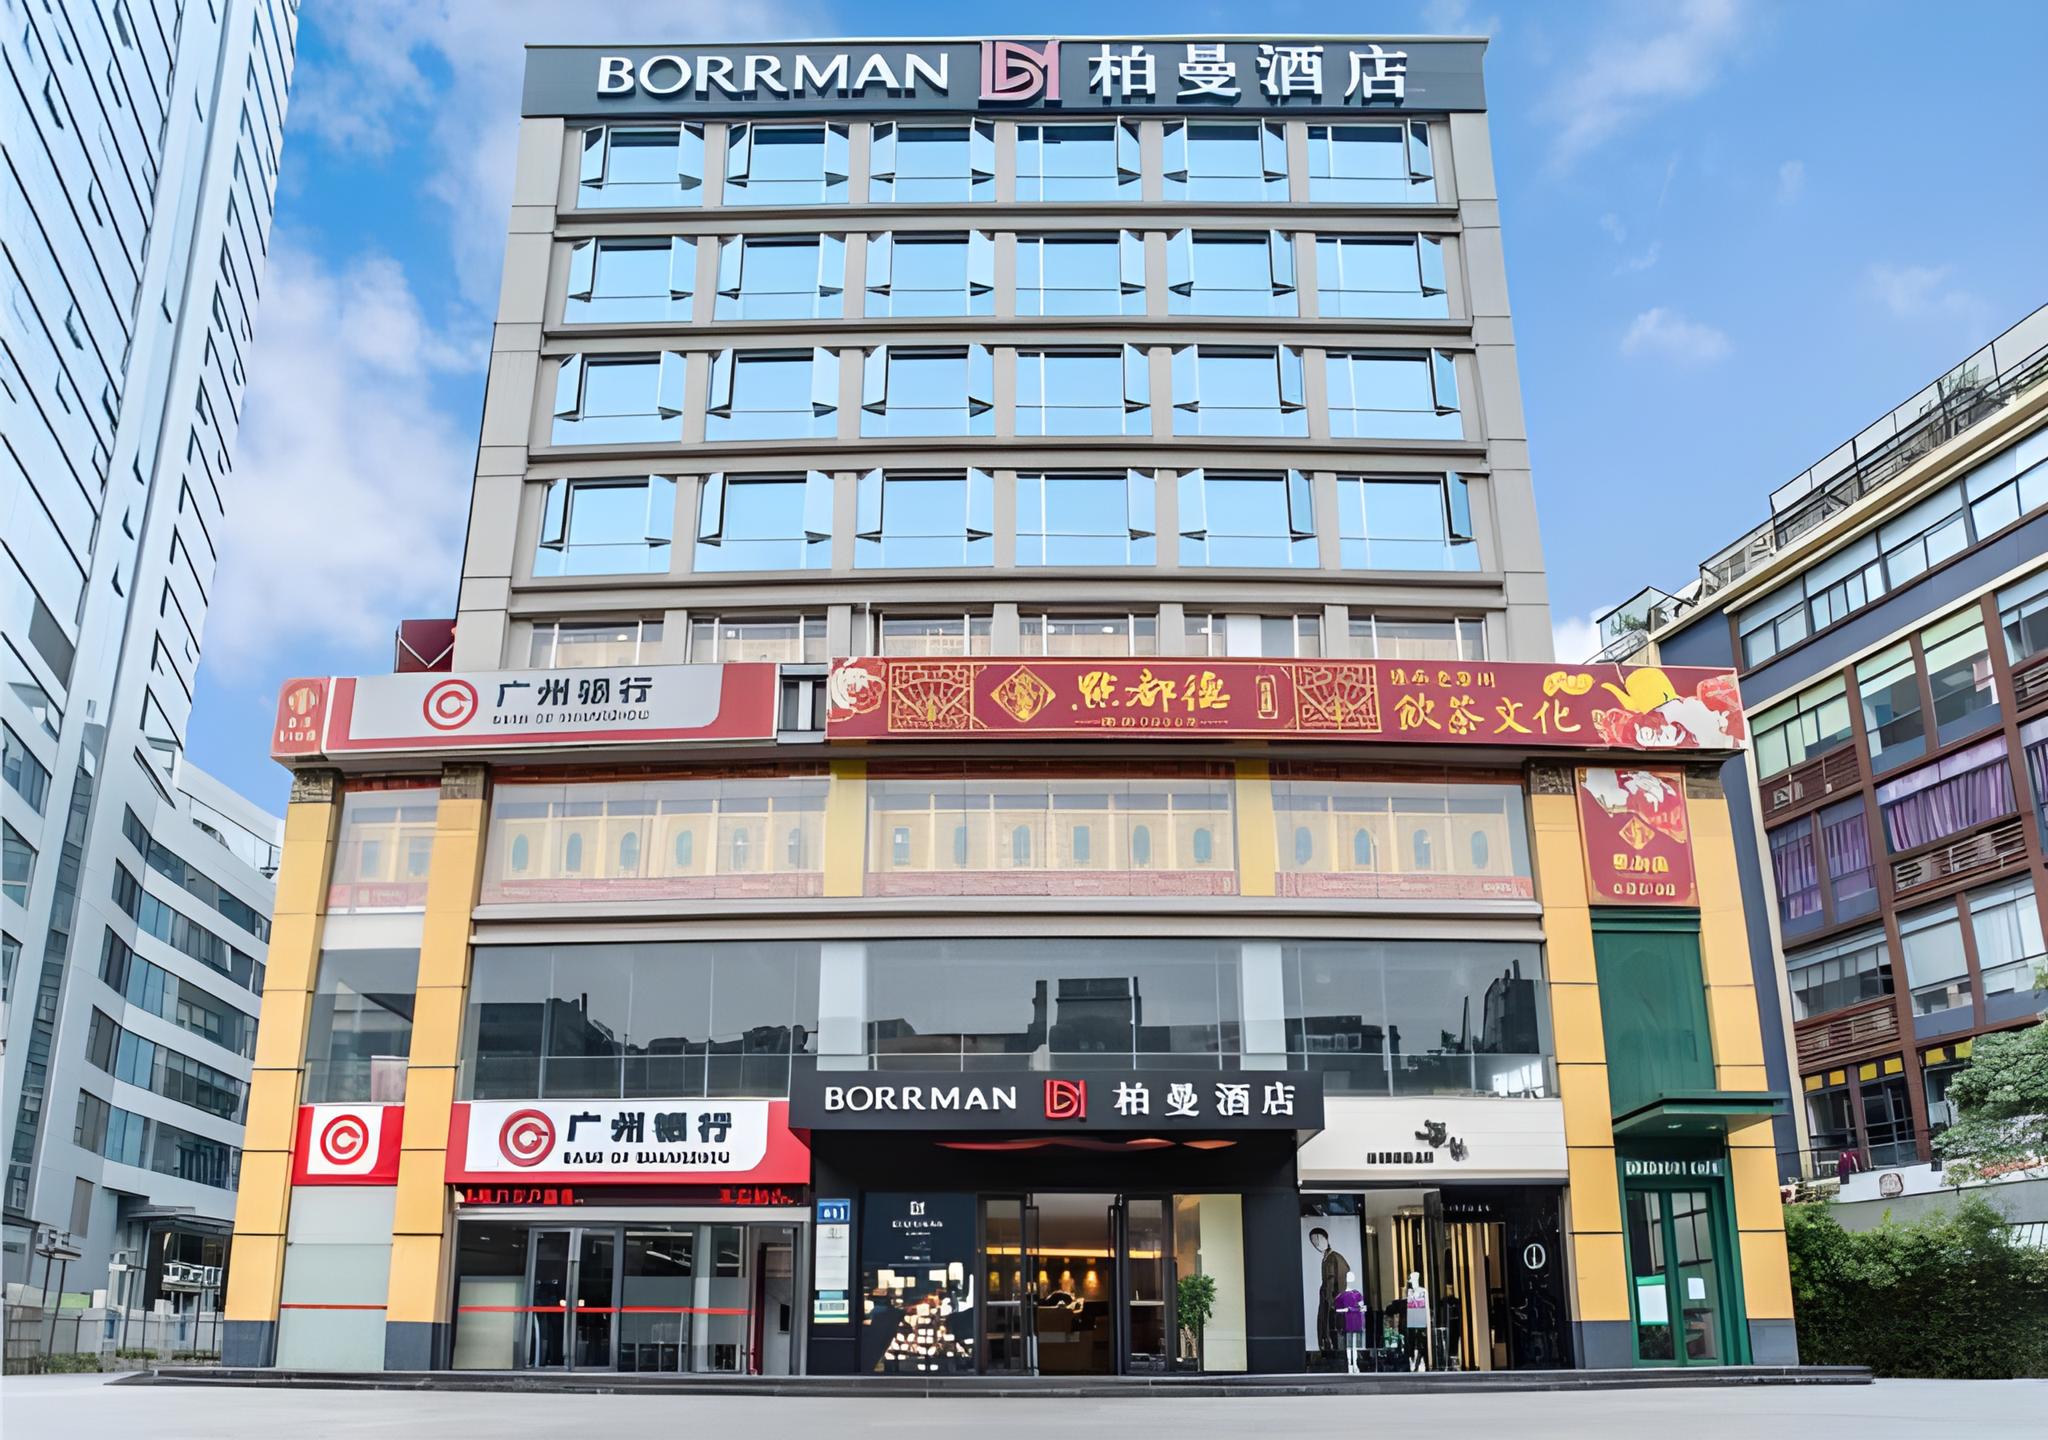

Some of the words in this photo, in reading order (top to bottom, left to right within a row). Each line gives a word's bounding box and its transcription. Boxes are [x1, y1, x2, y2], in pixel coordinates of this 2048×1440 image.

[597, 53, 949, 95] BORRMAN
[1088, 44, 1408, 98] 柏曼酒店
[825, 1086, 1017, 1111] BORRMAN
[1112, 1081, 1295, 1117] 柏曼酒店
